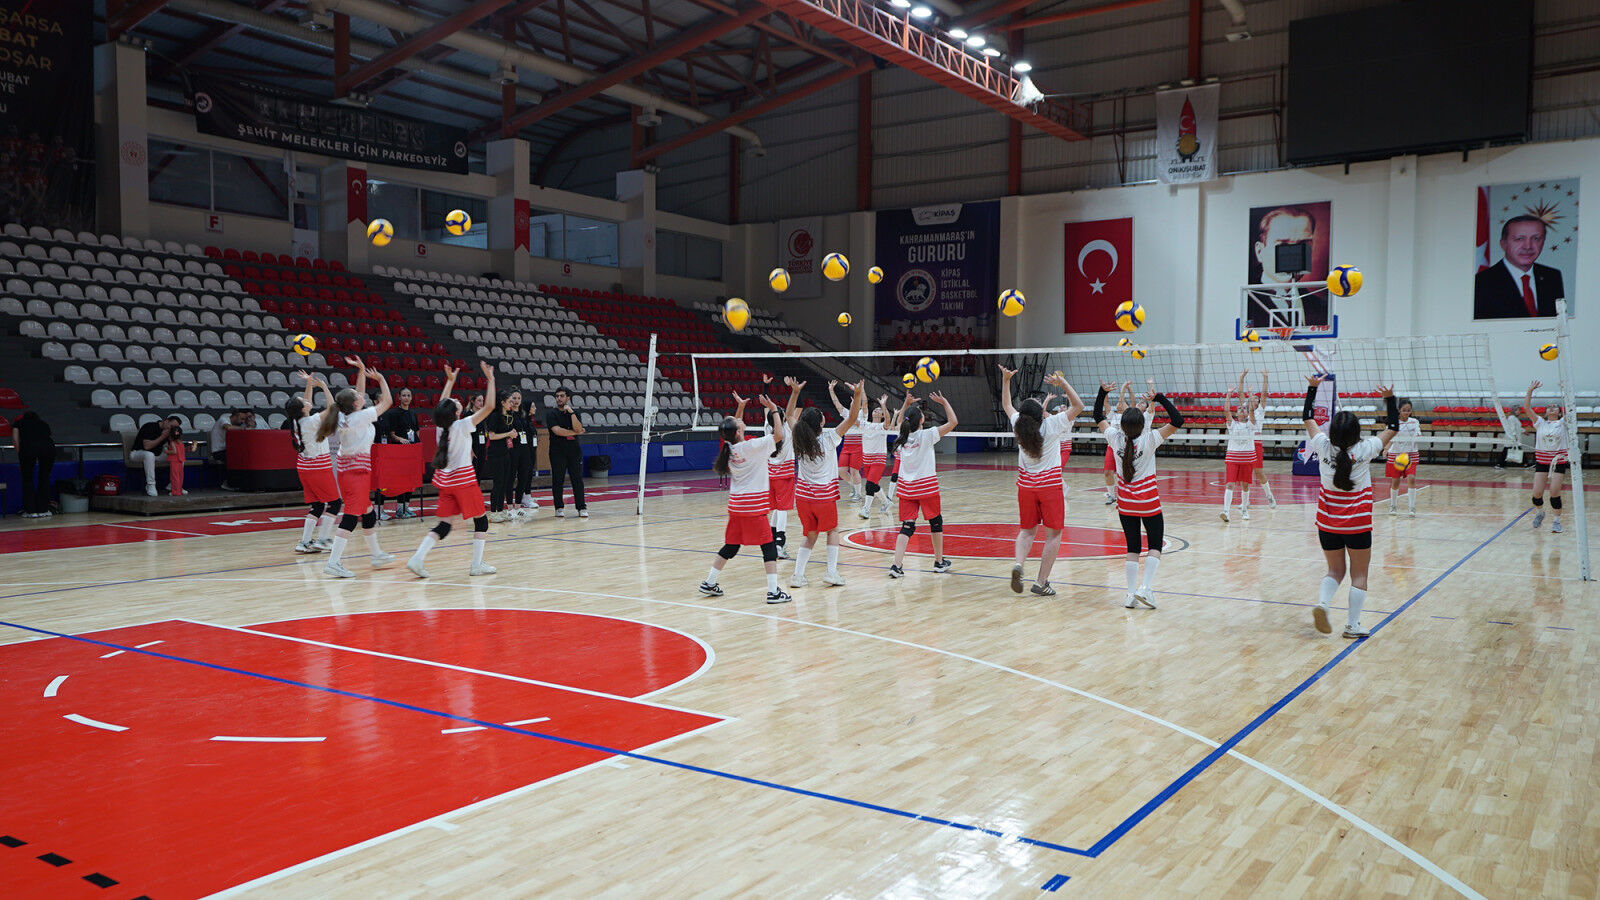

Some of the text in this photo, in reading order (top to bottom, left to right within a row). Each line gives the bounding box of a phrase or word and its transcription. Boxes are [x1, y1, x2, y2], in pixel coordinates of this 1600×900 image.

[238, 123, 447, 166] ŞEHİT MELEKLER İÇİN PARKEDEYİZ
[210, 215, 219, 228] F
[899, 230, 976, 245] KAHRAMANMARAŞ'IN
[417, 243, 426, 255] G
[907, 242, 967, 263] GURURU
[563, 263, 571, 273] G
[940, 268, 961, 278] KİPAŞ
[940, 289, 978, 300] BASKETBOL
[941, 301, 964, 311] TAKIMI
